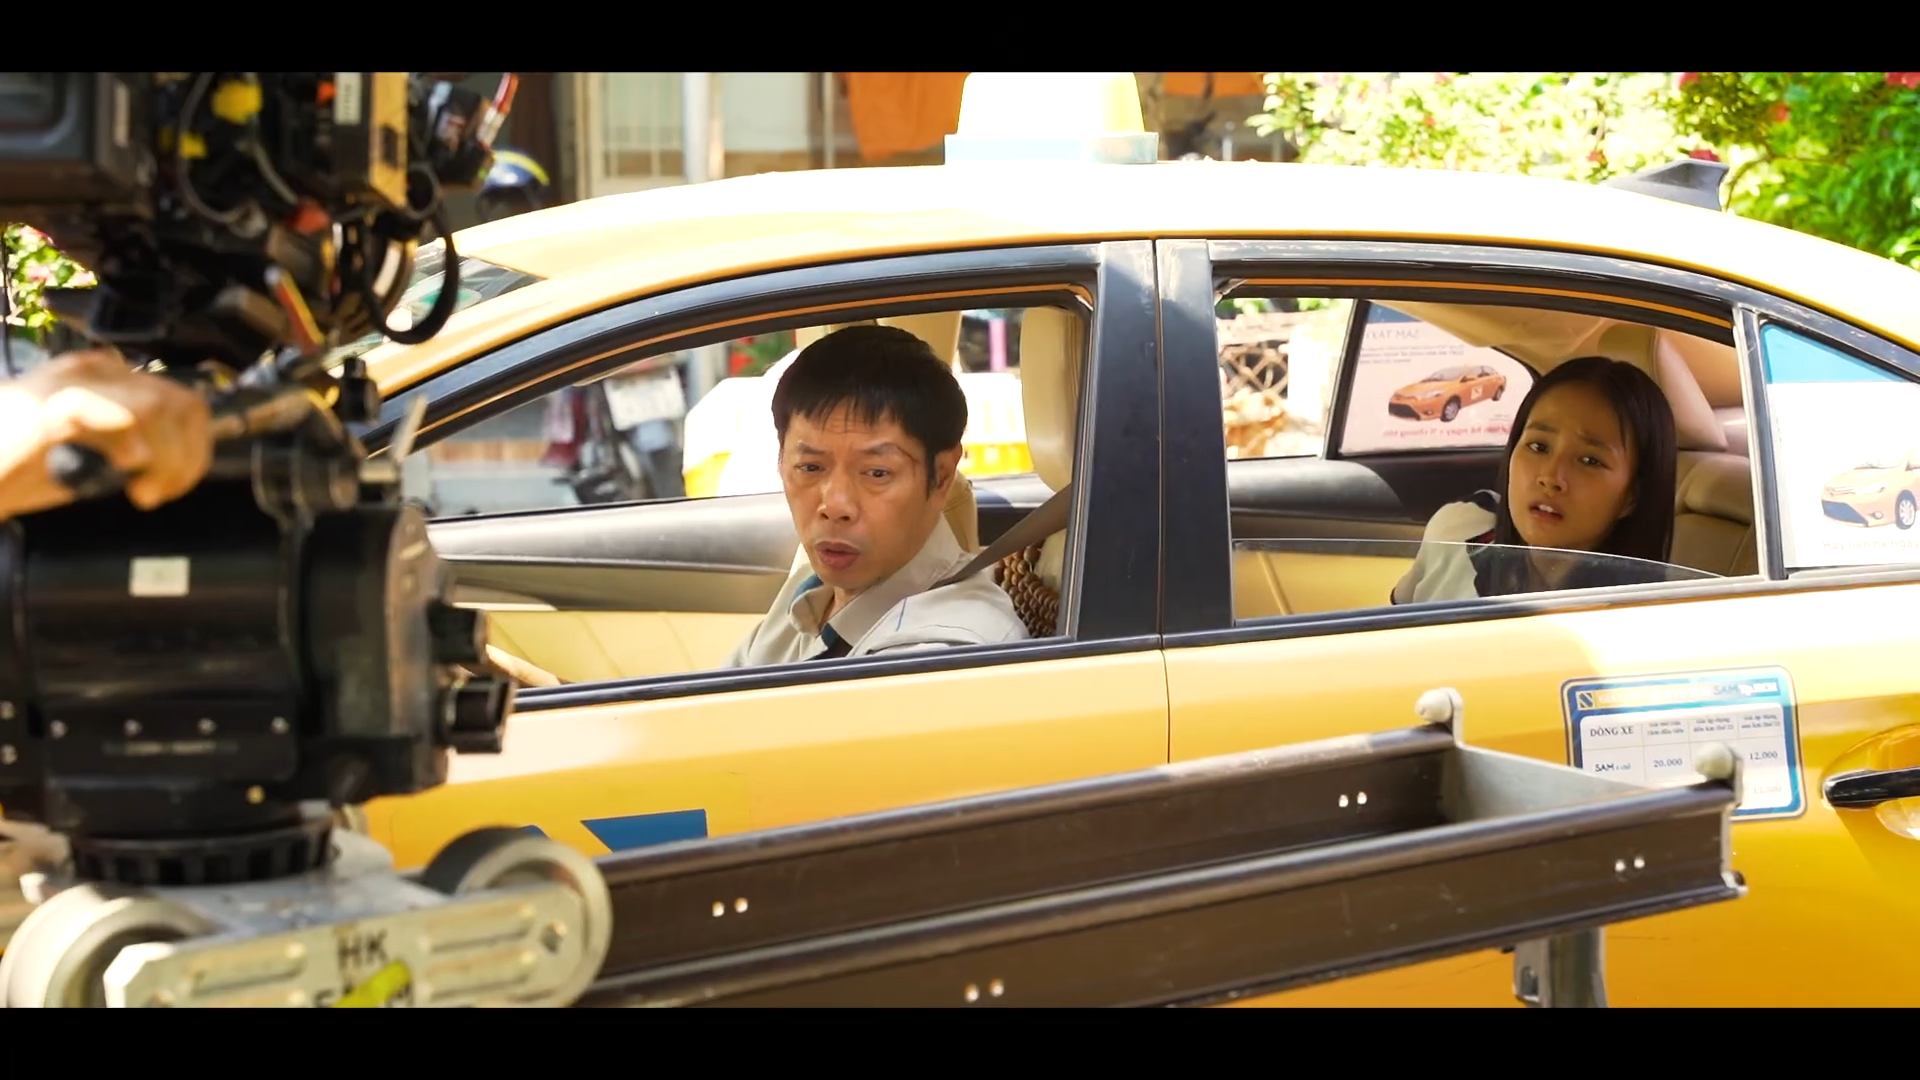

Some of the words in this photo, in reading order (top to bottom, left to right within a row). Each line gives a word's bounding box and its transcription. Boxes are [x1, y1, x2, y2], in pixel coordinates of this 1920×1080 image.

[1713, 684, 1739, 696] SAM
[1589, 726, 1619, 738] DÒNG
[1621, 725, 1635, 735] XE
[1749, 750, 1778, 760] 12.000
[1594, 763, 1615, 772] SAM
[1653, 758, 1683, 768] 20.000
[337, 929, 389, 970] HK
